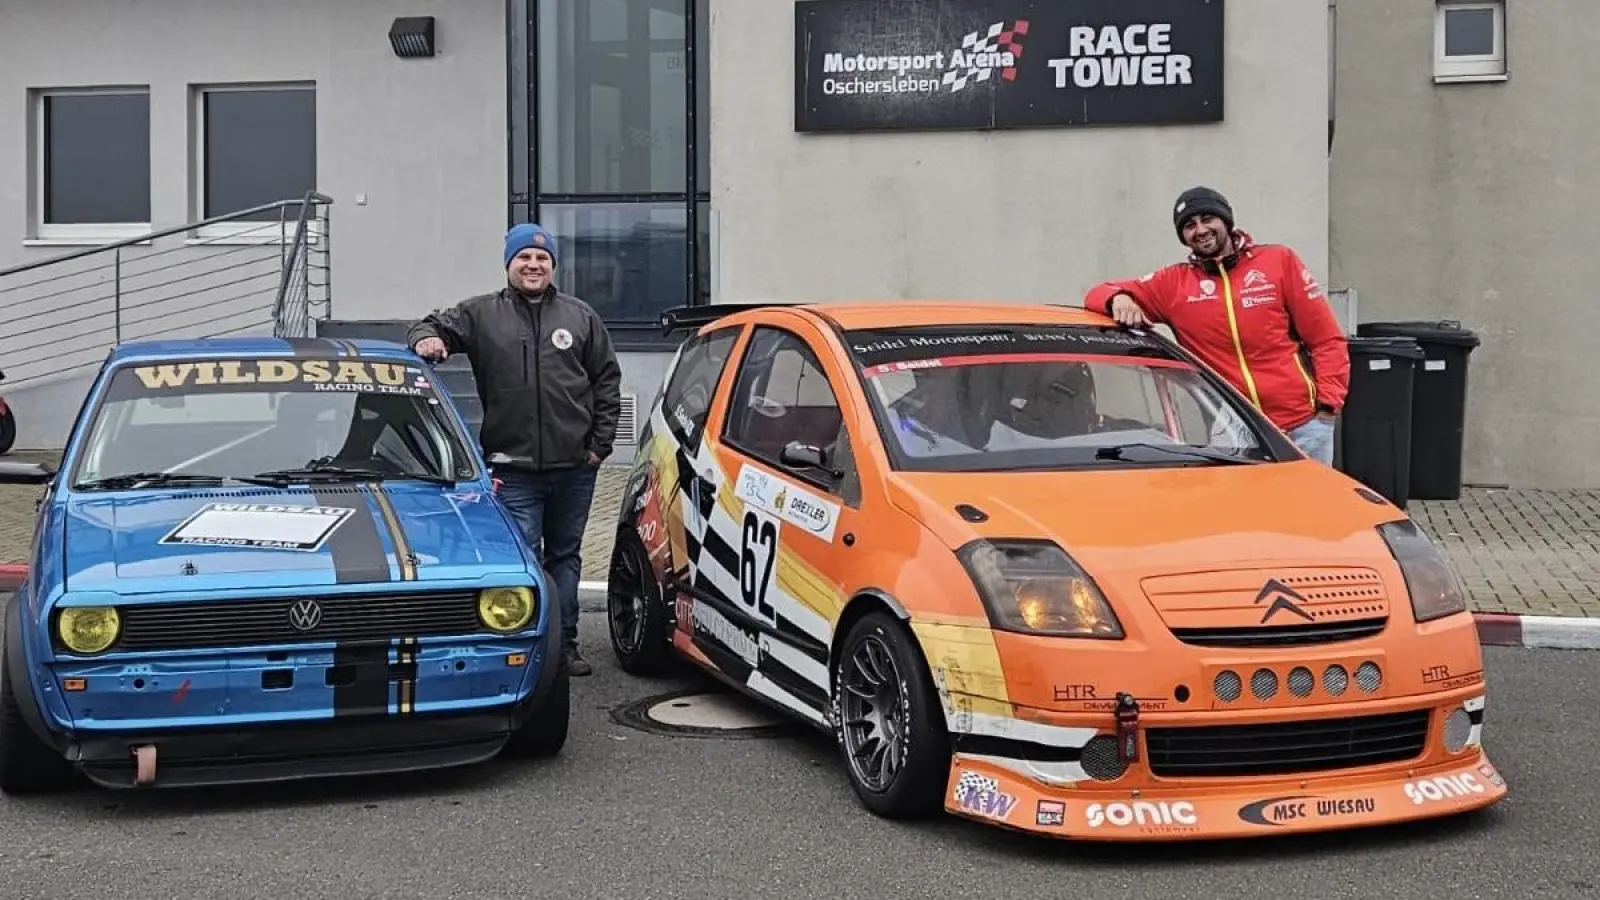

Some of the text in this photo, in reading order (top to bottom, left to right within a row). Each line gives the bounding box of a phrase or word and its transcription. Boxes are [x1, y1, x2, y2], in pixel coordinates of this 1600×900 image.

[1070, 23, 1171, 57] RACE
[823, 48, 1014, 76] Motorsport Arena
[1048, 54, 1192, 88] TOWER
[823, 77, 940, 95] Oschersleben
[133, 359, 408, 389] WILDSAU
[314, 382, 422, 396] RACING TEAM
[212, 503, 347, 517] WILDSAU
[791, 497, 826, 522] DREXLER
[181, 537, 301, 549] RACING TEAM
[740, 511, 777, 621] 62
[1422, 664, 1450, 680] HTR
[1054, 684, 1097, 699] HTR
[1273, 798, 1376, 821] MSC WIESAU
